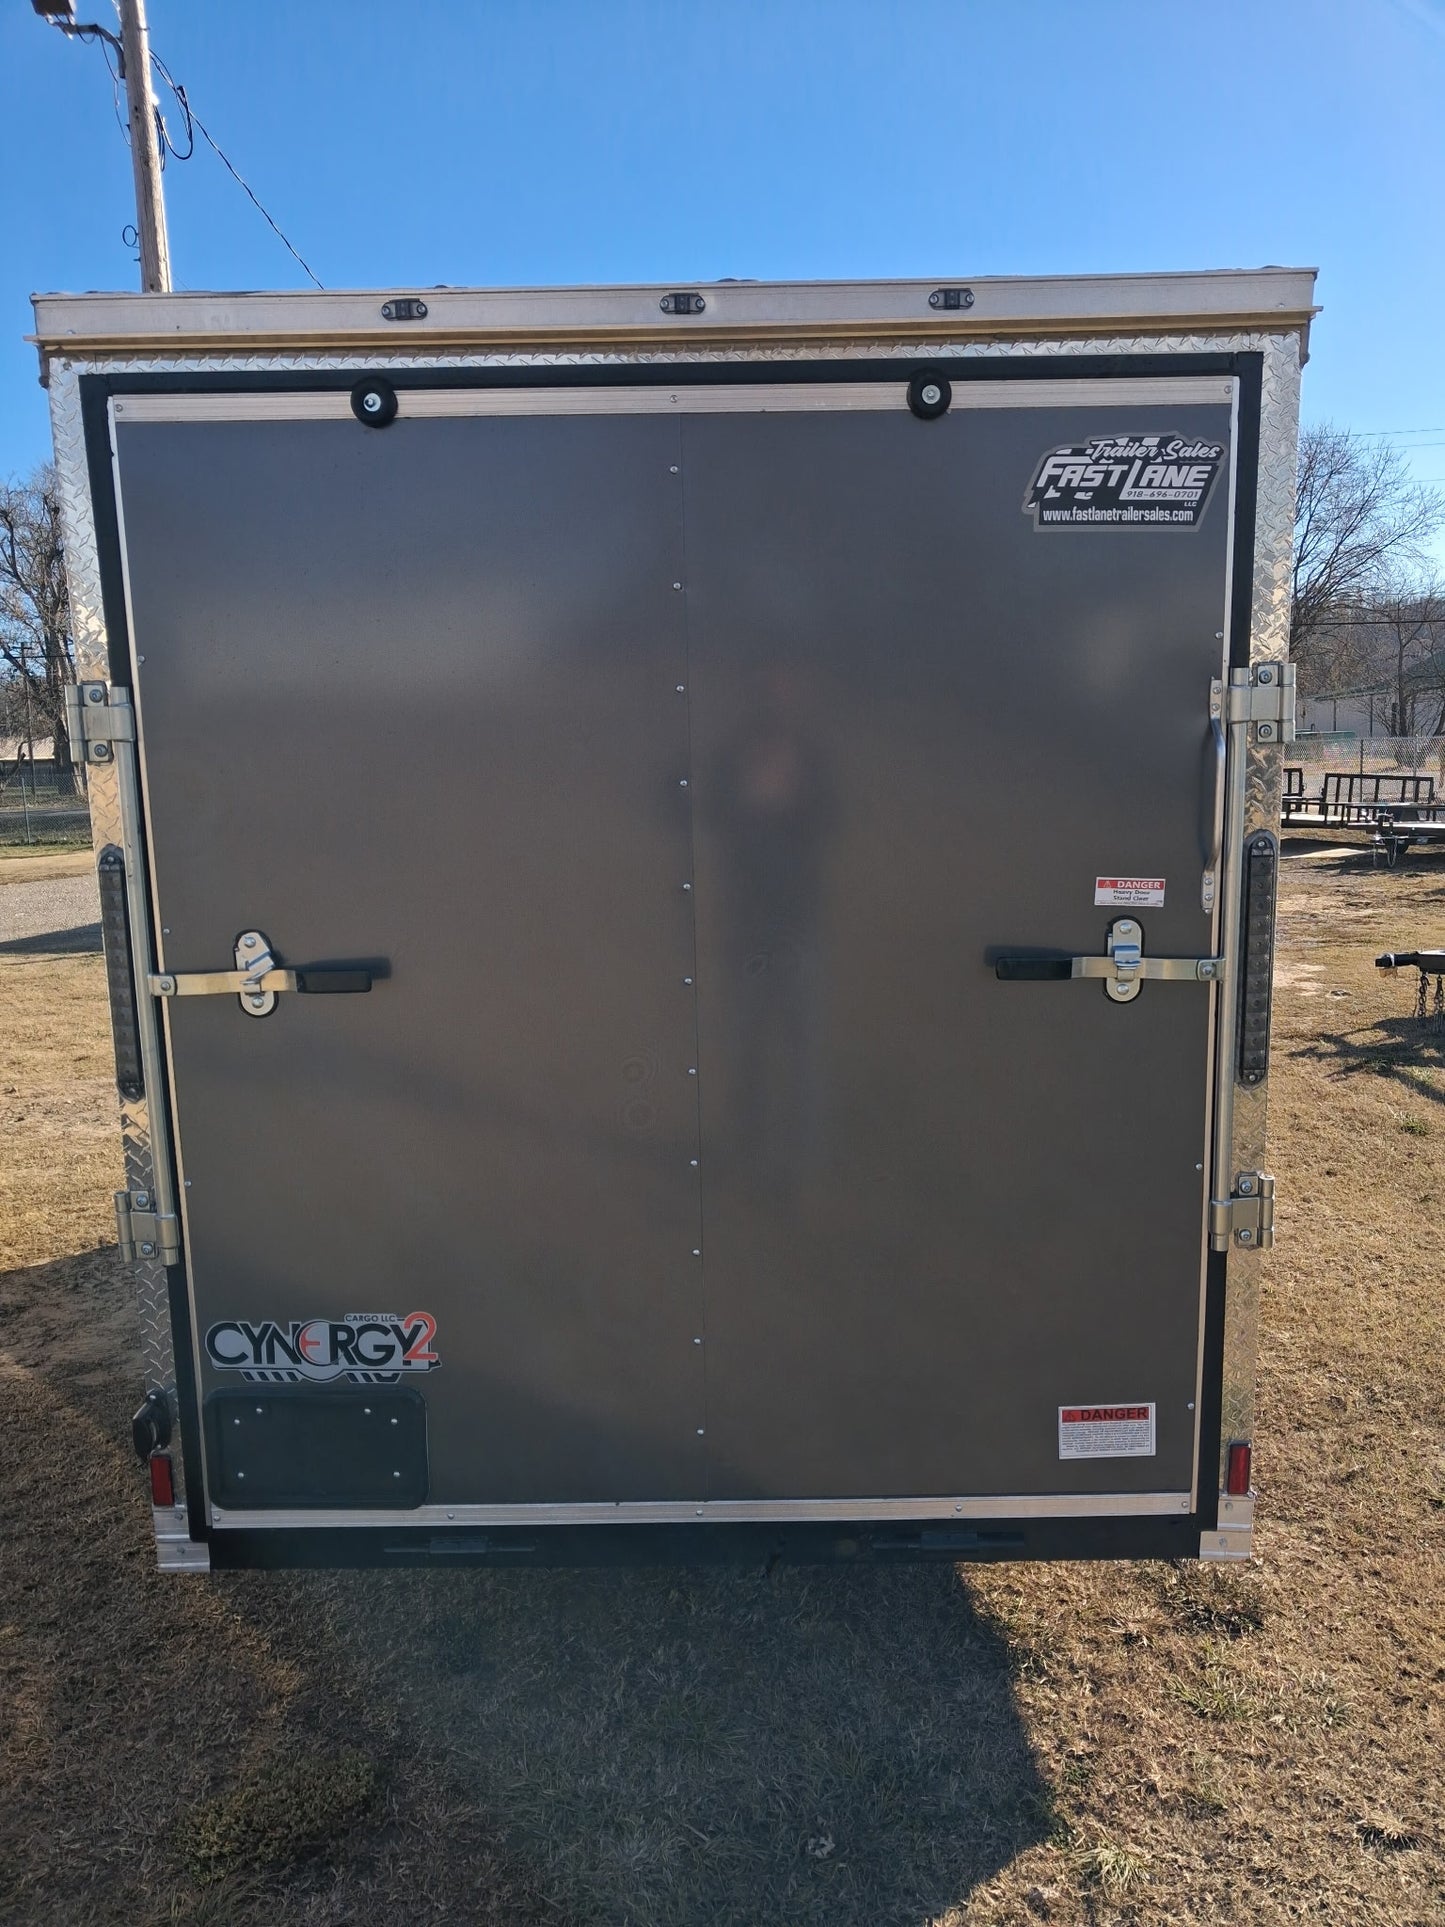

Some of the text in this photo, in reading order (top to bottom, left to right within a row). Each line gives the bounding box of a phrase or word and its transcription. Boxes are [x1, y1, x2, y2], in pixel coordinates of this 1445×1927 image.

[1091, 440, 1220, 460] Trailer Sales
[1126, 490, 1199, 499] 918-696-0701
[1043, 506, 1194, 521] www.fastlanetrailersales.com
[1117, 881, 1161, 889] DANGER
[345, 1314, 396, 1323] CARGO LLC
[1080, 1407, 1147, 1421] DANGER
